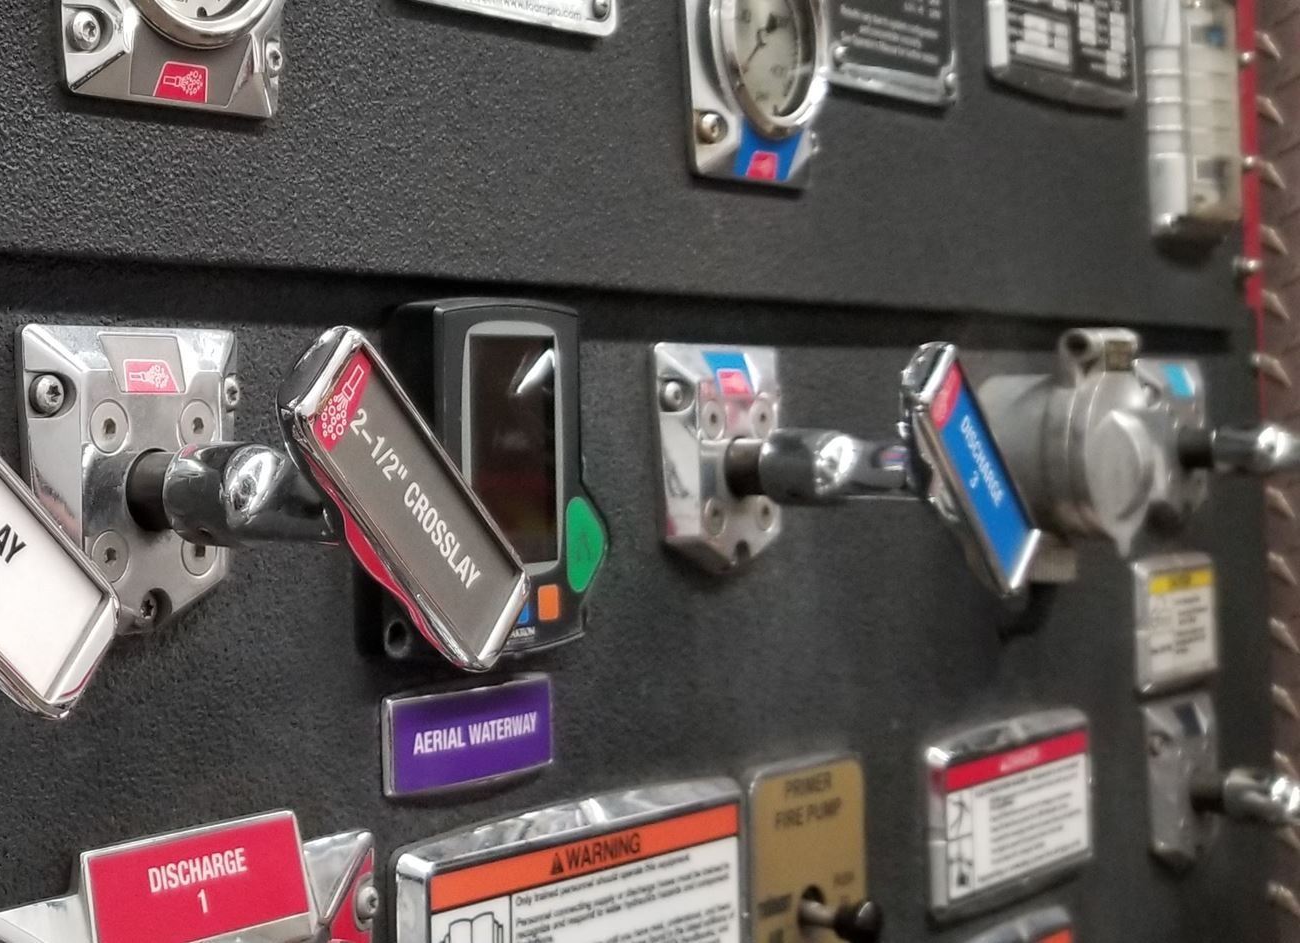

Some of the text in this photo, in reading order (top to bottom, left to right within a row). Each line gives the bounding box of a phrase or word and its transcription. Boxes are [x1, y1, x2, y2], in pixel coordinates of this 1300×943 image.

[960, 414, 1005, 507] DISCHARGE
[403, 481, 482, 590] CROSSLAY
[413, 711, 538, 756] AERIAL WATERWAY
[785, 771, 833, 797] PRIMER
[774, 797, 844, 830] FIRE PUMP
[147, 847, 248, 893] DISCHARGE
[566, 832, 642, 871] WARNING
[196, 888, 209, 914] 1
